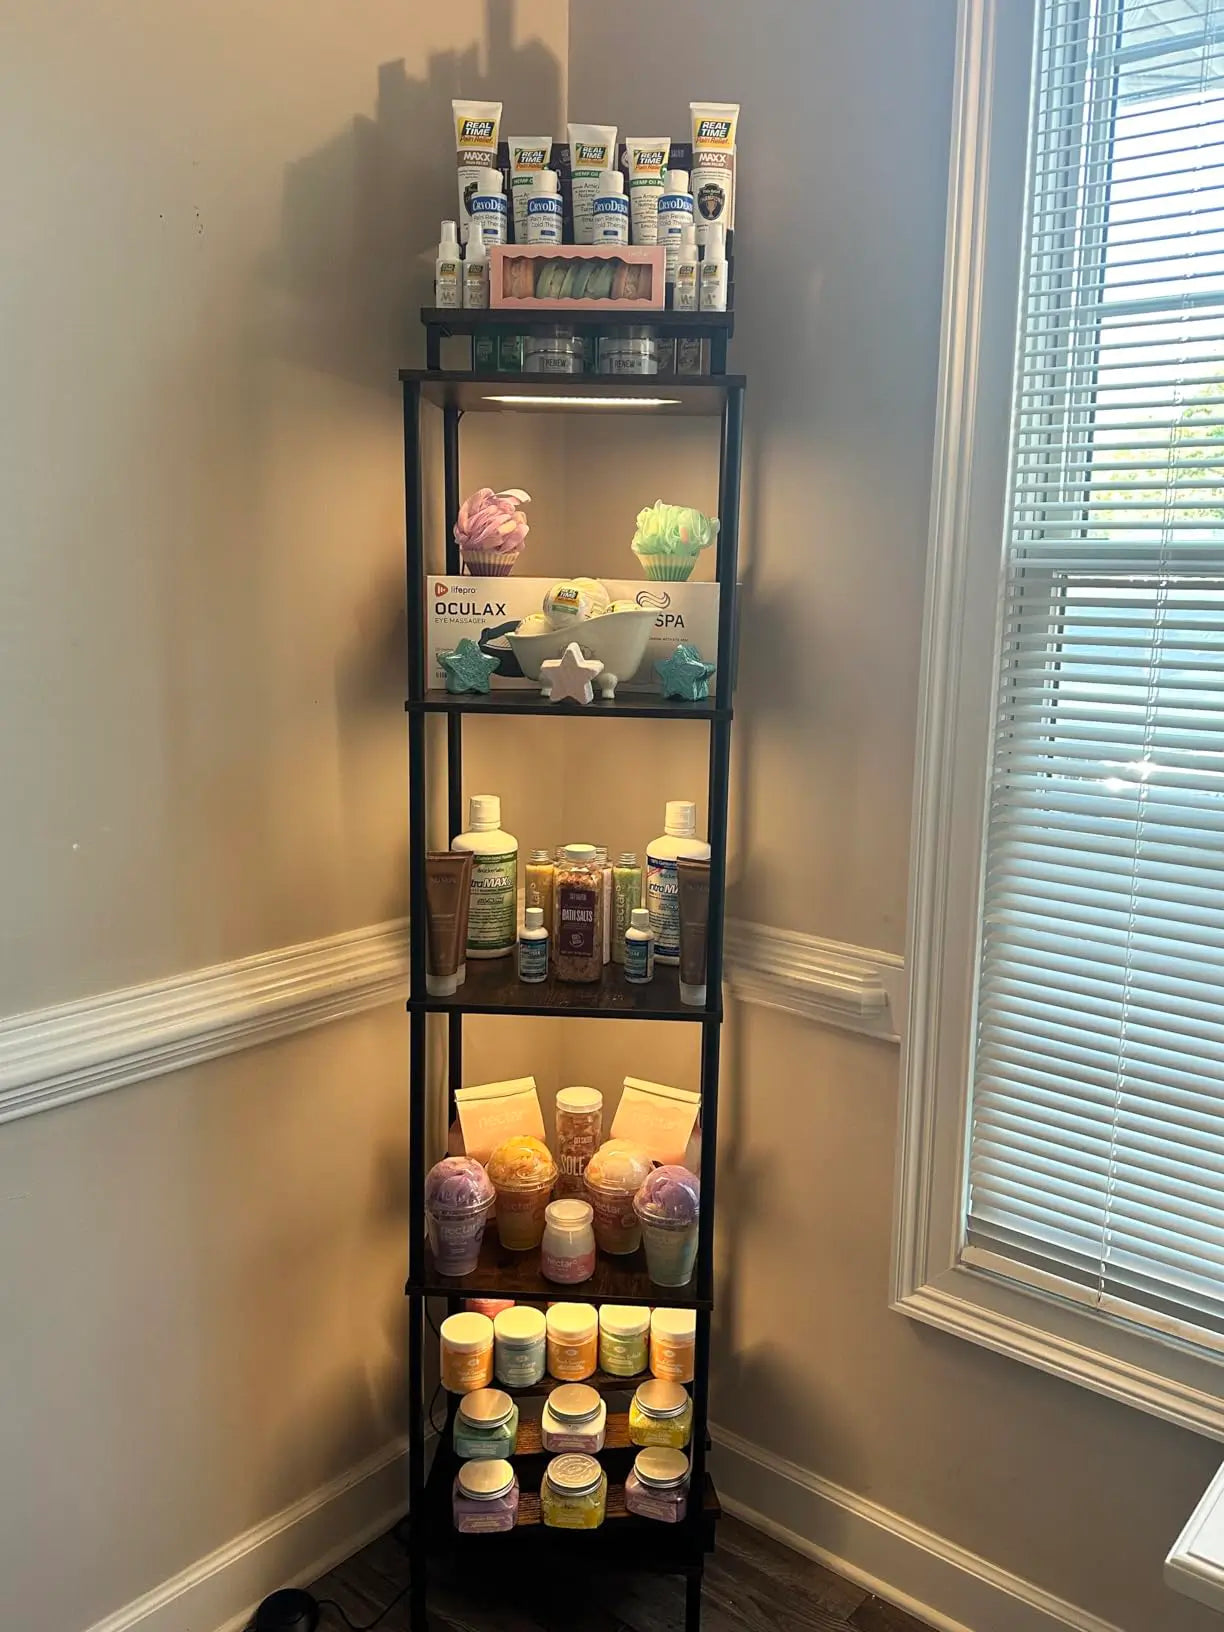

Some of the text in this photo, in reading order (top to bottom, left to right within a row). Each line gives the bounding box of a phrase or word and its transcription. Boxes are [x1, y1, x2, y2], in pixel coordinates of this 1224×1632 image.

[465, 121, 492, 129] REAL
[701, 121, 728, 129] REAL
[465, 128, 490, 136] TIME
[701, 129, 726, 137] TIME
[463, 151, 491, 161] MAXX
[699, 152, 726, 163] MAXX
[613, 359, 635, 369] RENEW
[451, 586, 476, 595] lifepro
[434, 602, 507, 616] OCULAX
[449, 617, 487, 625] MASSAGER
[654, 613, 685, 629] SPA
[561, 908, 593, 922] BATH SALTS
[560, 1154, 585, 1176] SOLE
